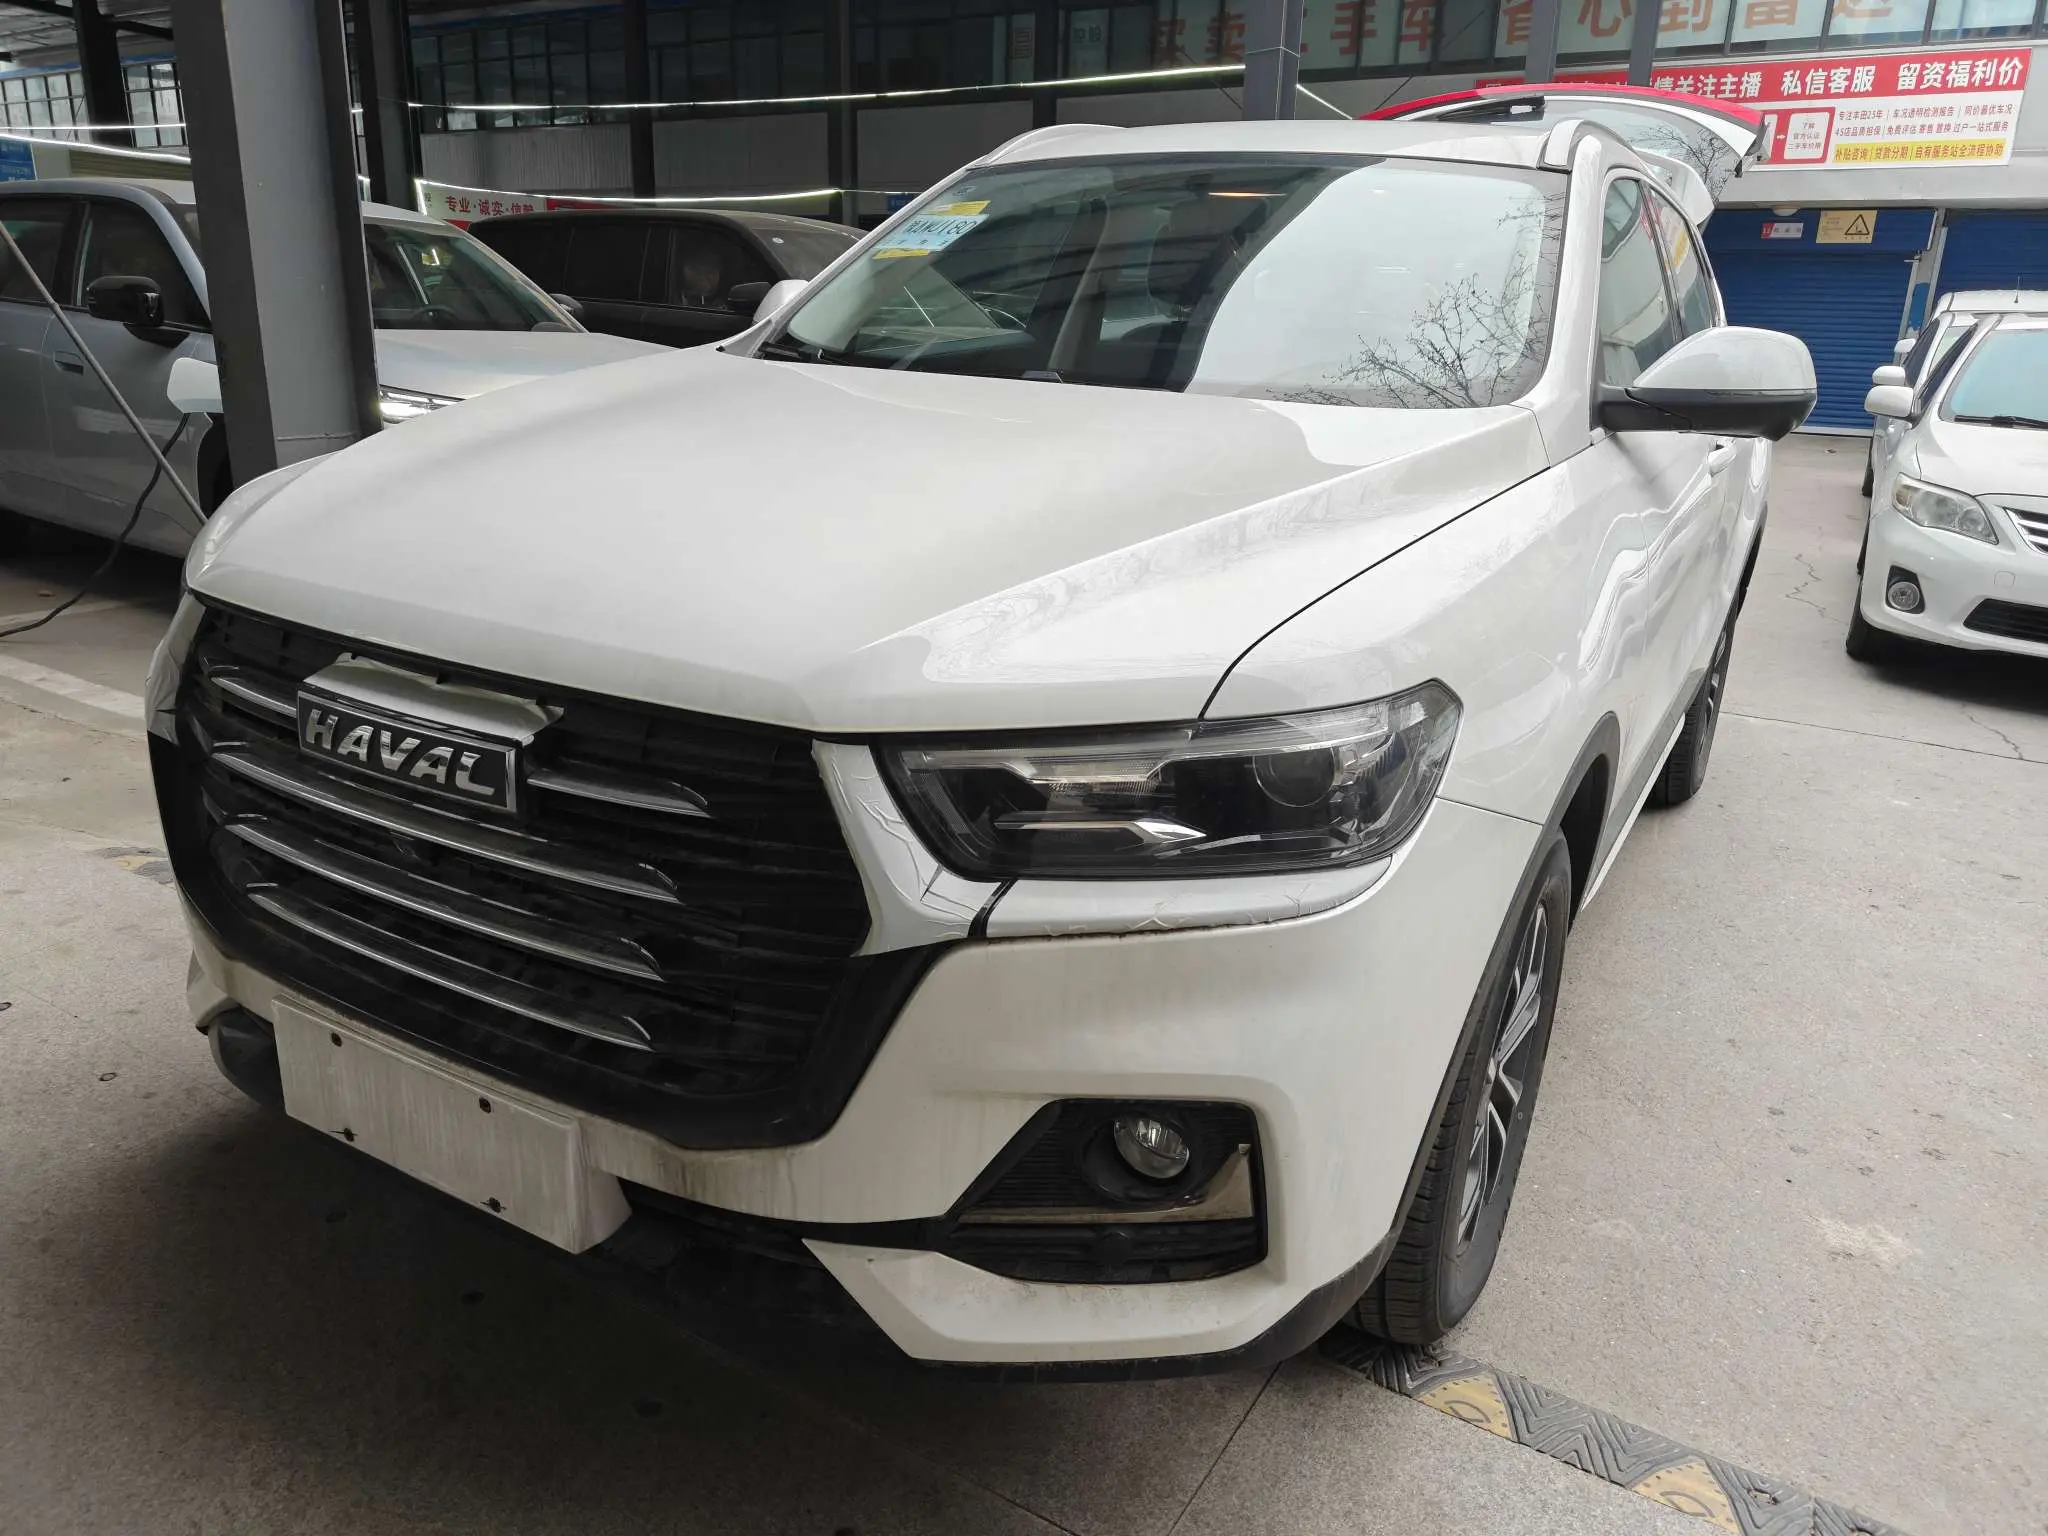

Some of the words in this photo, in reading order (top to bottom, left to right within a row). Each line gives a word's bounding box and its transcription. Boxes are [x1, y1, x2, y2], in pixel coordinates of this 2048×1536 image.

[1650, 71, 1762, 98] 情关注主播
[1781, 65, 1876, 96] 私信客服
[1897, 56, 2024, 90] 留资福利价
[1953, 120, 2009, 133] 过户一站式服务
[1915, 143, 2004, 159] 自有服务站全流程协助
[305, 708, 495, 796] HAVAL
